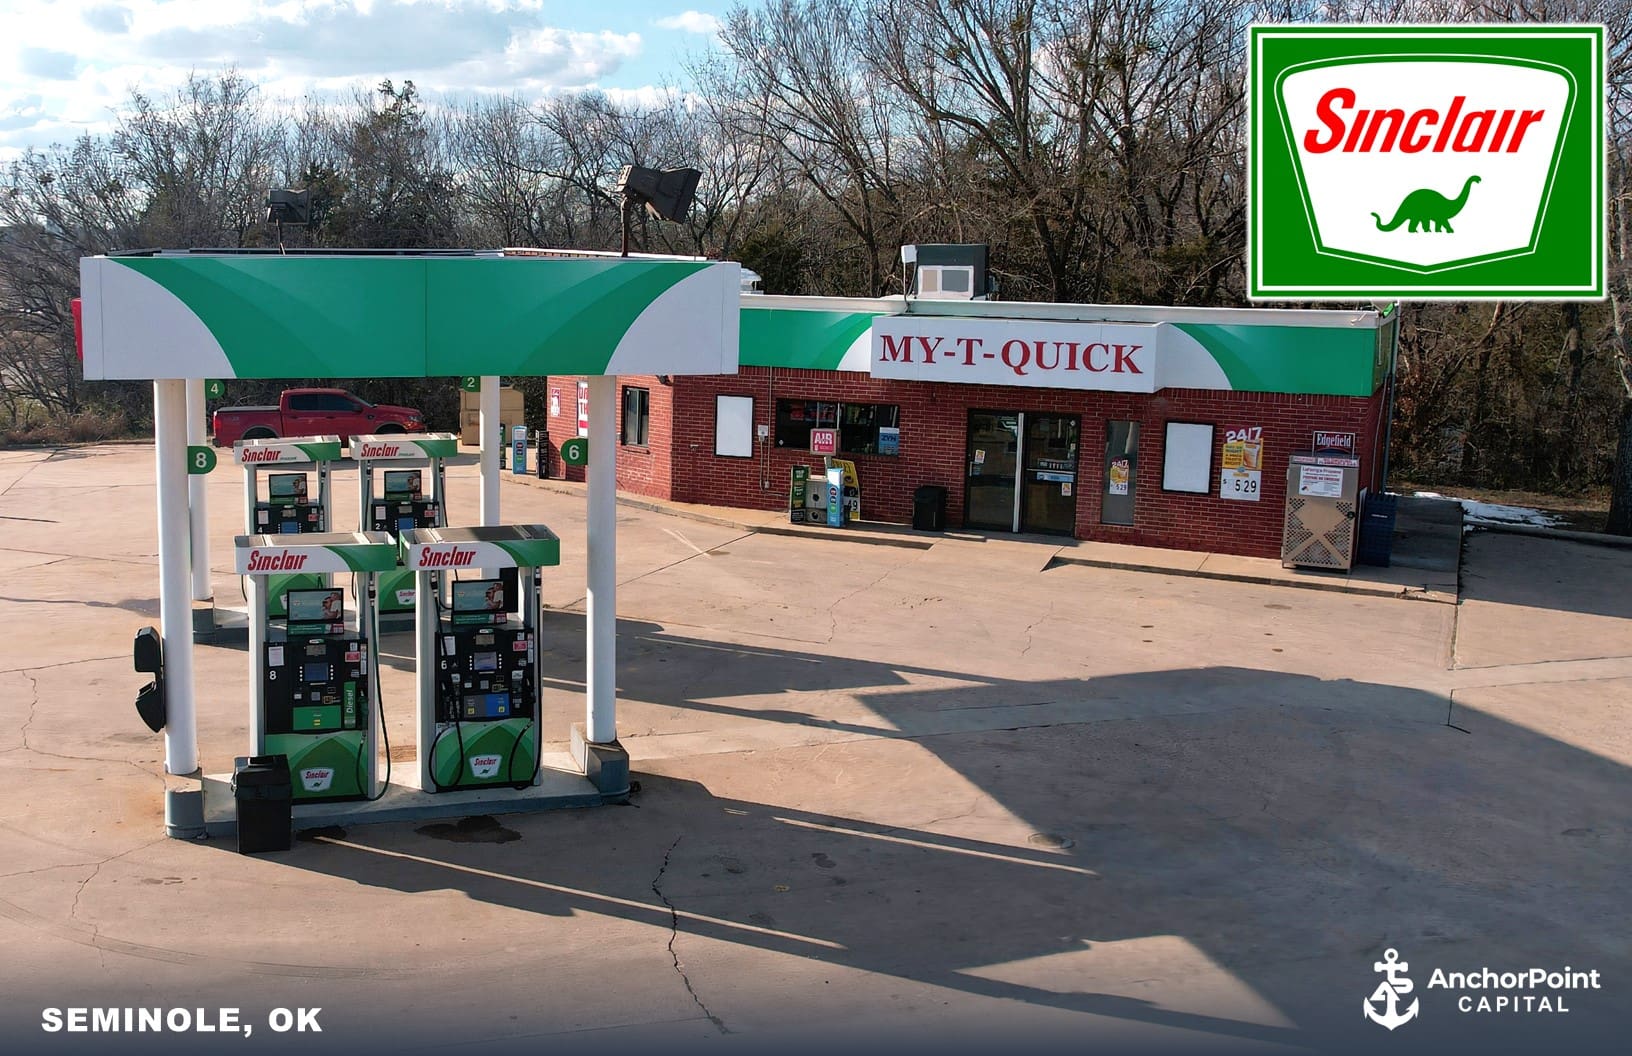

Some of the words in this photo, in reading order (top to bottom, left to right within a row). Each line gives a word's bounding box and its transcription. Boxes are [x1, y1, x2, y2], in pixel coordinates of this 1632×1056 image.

[879, 334, 1144, 376] MY-T-QUICK
[210, 383, 219, 395] 4
[467, 377, 475, 388] 2
[814, 432, 833, 445] AIR
[1316, 433, 1351, 448] Edgefield
[241, 443, 282, 463] Sinclair
[361, 443, 400, 458] Sinclair
[569, 445, 580, 460] 6
[195, 452, 207, 468] 8
[247, 549, 308, 571] Sinclair
[419, 545, 476, 567] Sinclair
[441, 660, 447, 670] 6
[269, 670, 277, 681] 8
[346, 688, 354, 714] Diesel
